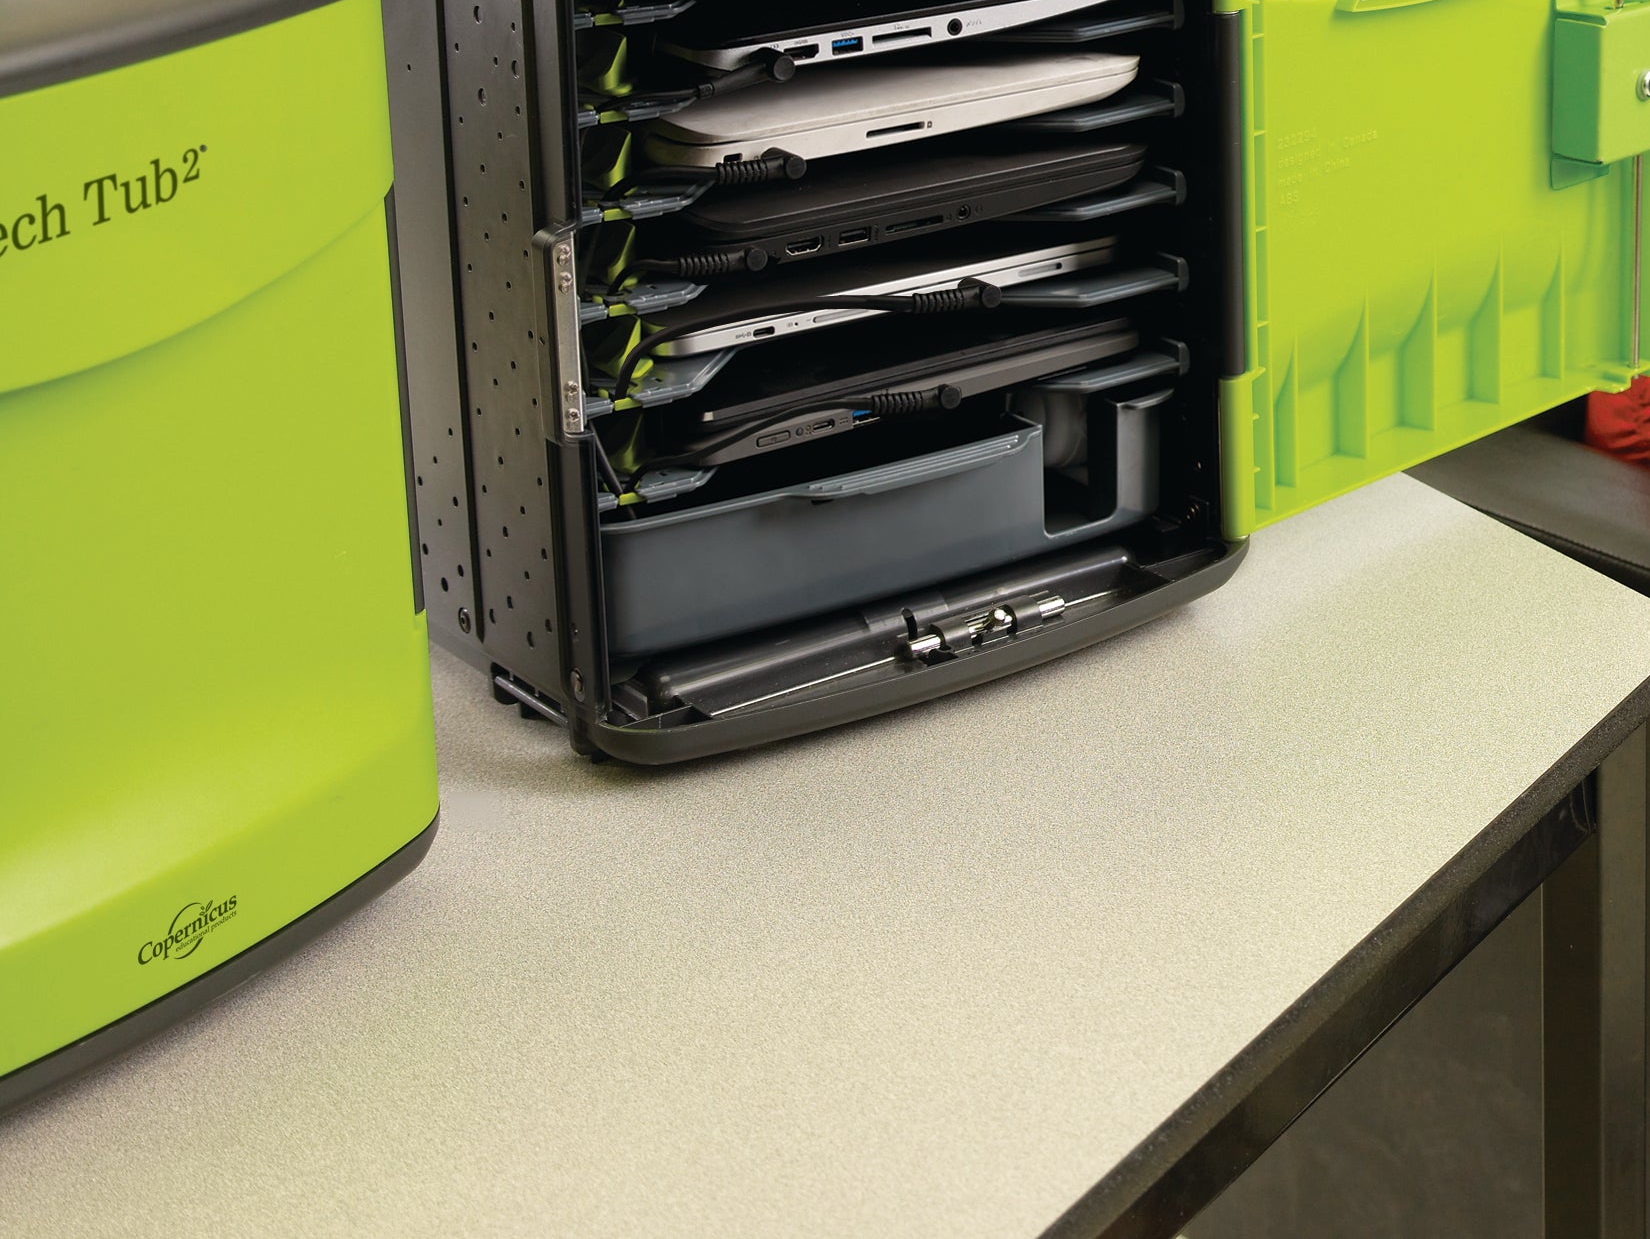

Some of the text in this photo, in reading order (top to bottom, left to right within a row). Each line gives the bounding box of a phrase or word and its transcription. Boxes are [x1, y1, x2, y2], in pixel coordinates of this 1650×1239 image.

[138, 894, 238, 966] Copernicus
[175, 910, 237, 952] educational products
